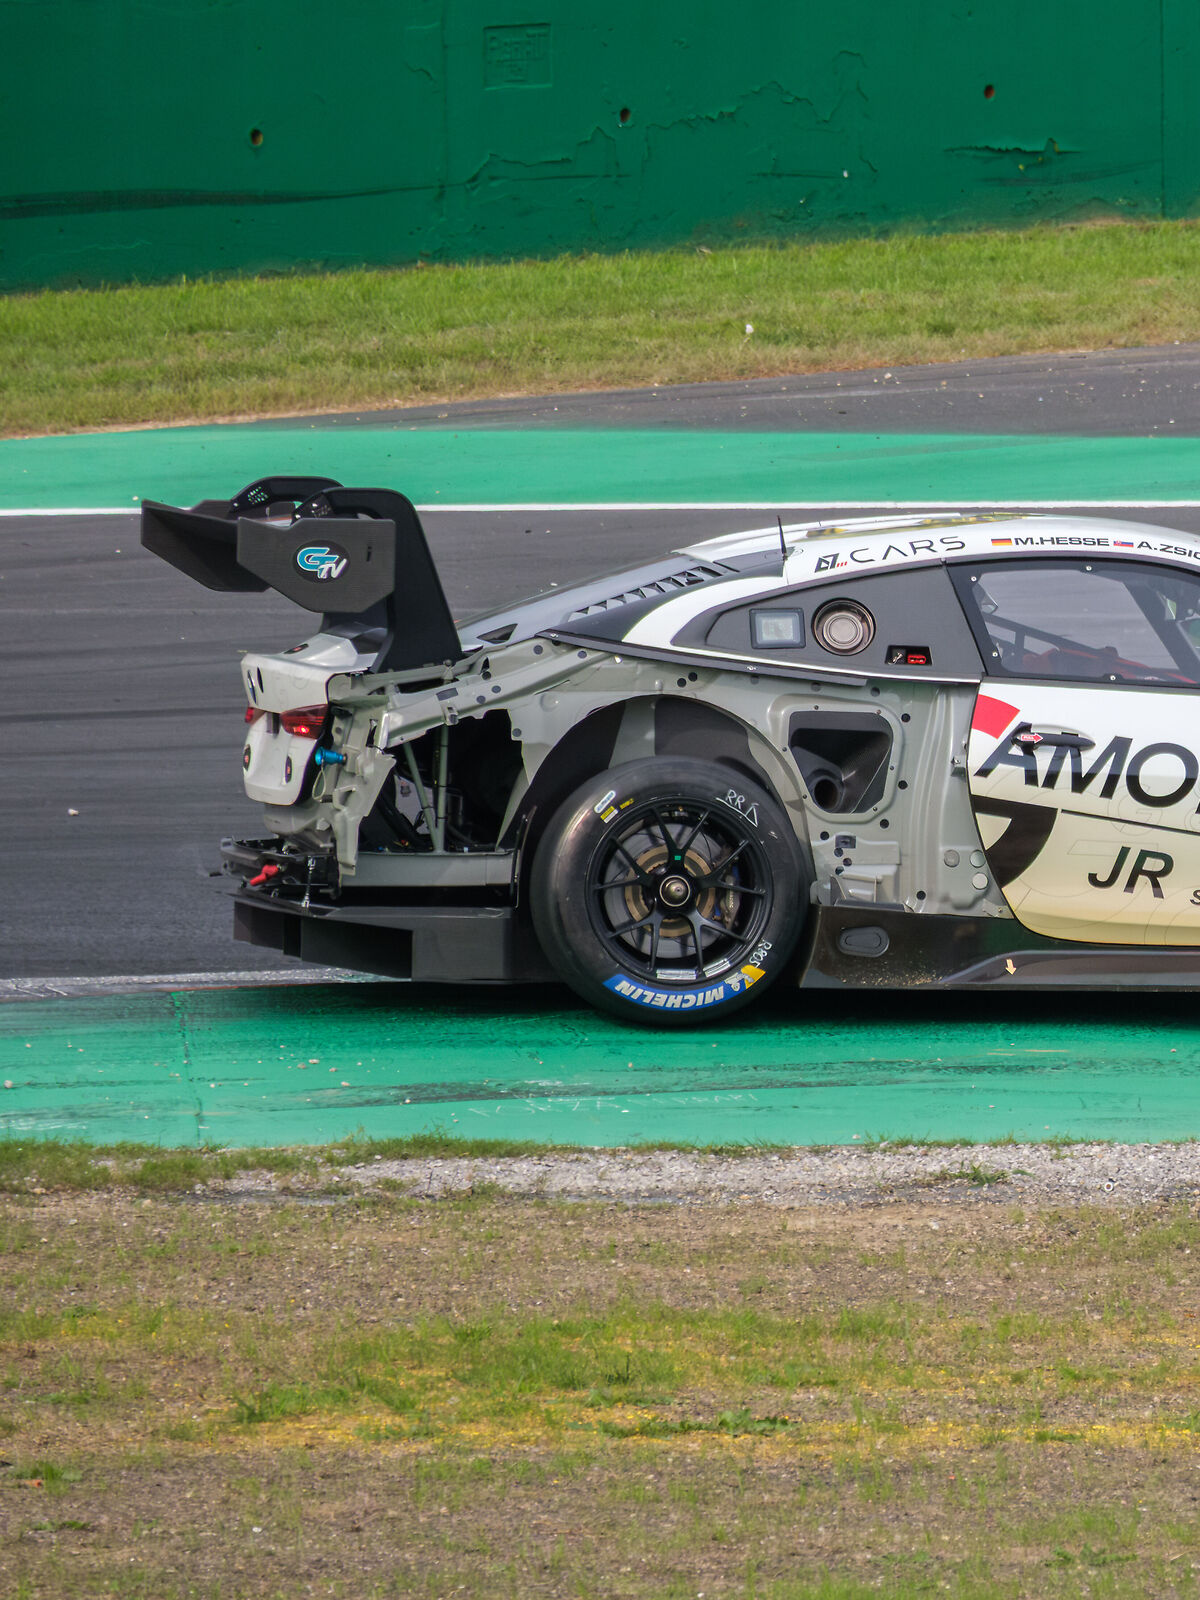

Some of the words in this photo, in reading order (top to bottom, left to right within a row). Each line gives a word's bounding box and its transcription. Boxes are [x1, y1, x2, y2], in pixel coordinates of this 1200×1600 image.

[849, 535, 966, 563] CARS
[1014, 537, 1110, 547] M.HESSE
[1087, 845, 1174, 900] JR
[614, 979, 725, 1009] MICHELIN
